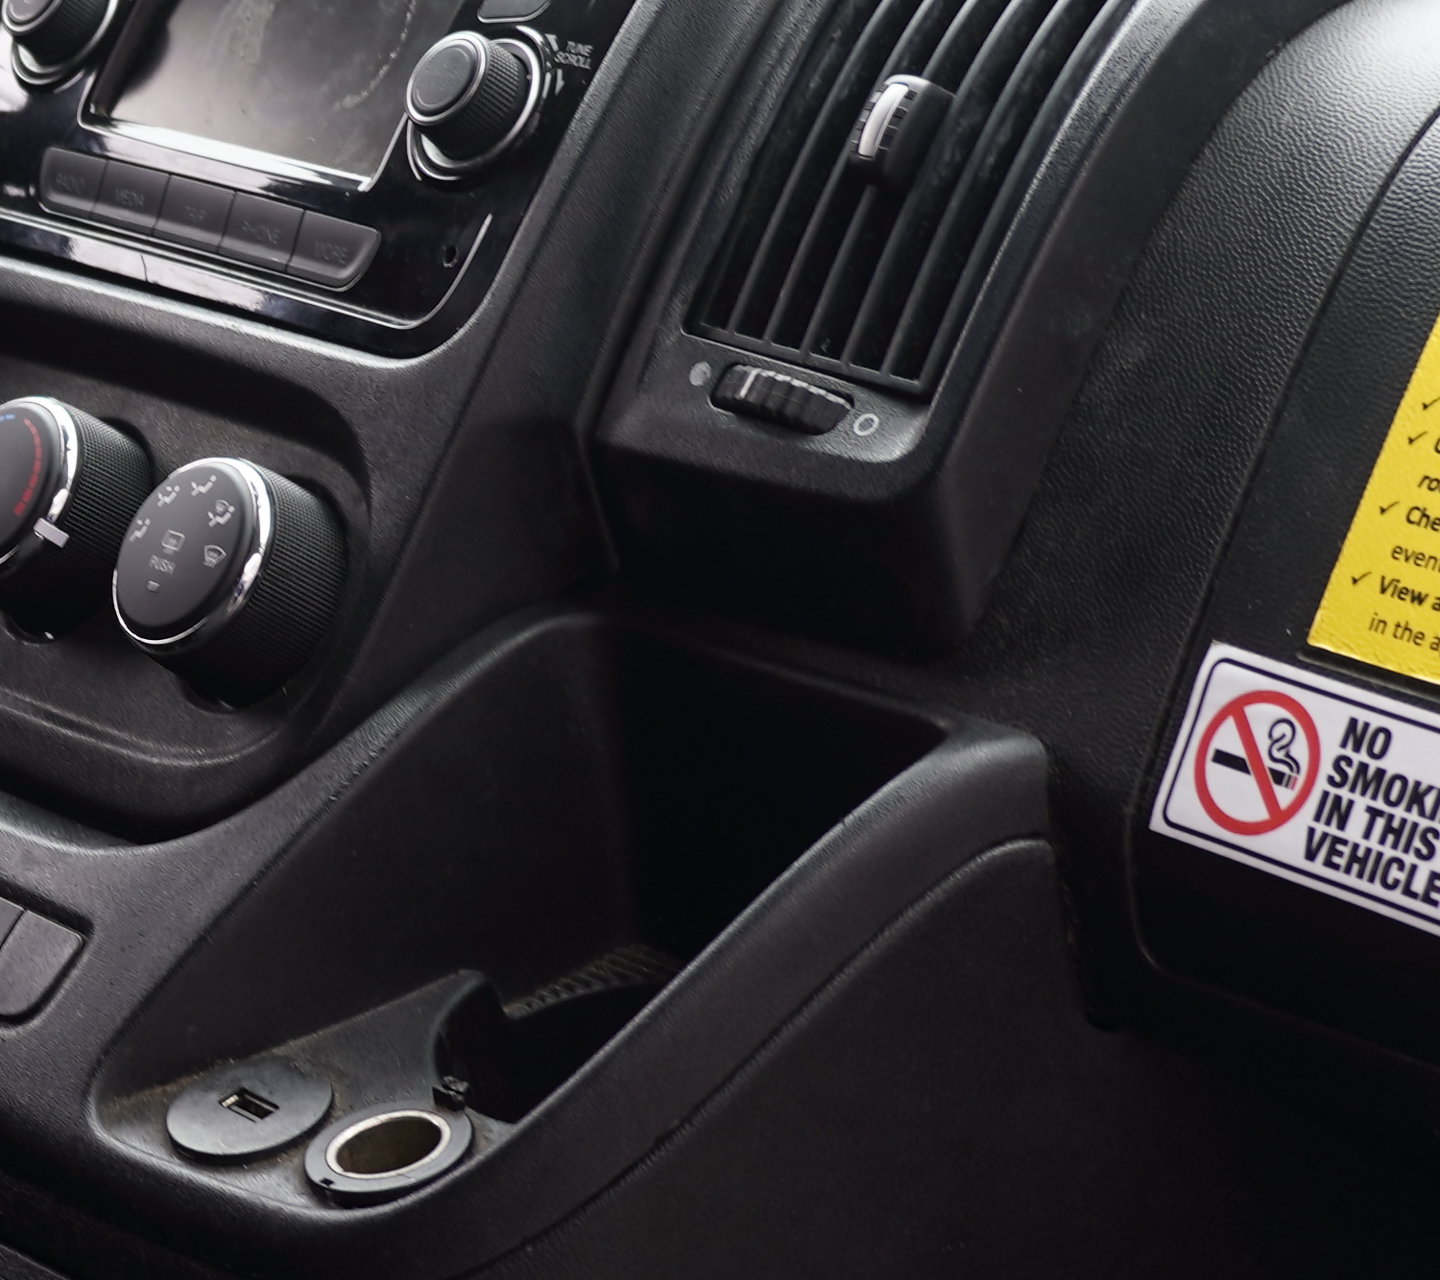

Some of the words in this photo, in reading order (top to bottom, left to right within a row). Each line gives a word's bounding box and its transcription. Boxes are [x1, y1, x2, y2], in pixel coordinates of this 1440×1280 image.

[553, 50, 593, 70] SCROLL
[566, 40, 594, 57] TUNE
[149, 554, 176, 576] PUSH
[1378, 573, 1430, 607] View
[1367, 611, 1388, 635] in
[1391, 620, 1426, 647] the
[1338, 716, 1393, 761] NO
[1312, 790, 1356, 834] IN
